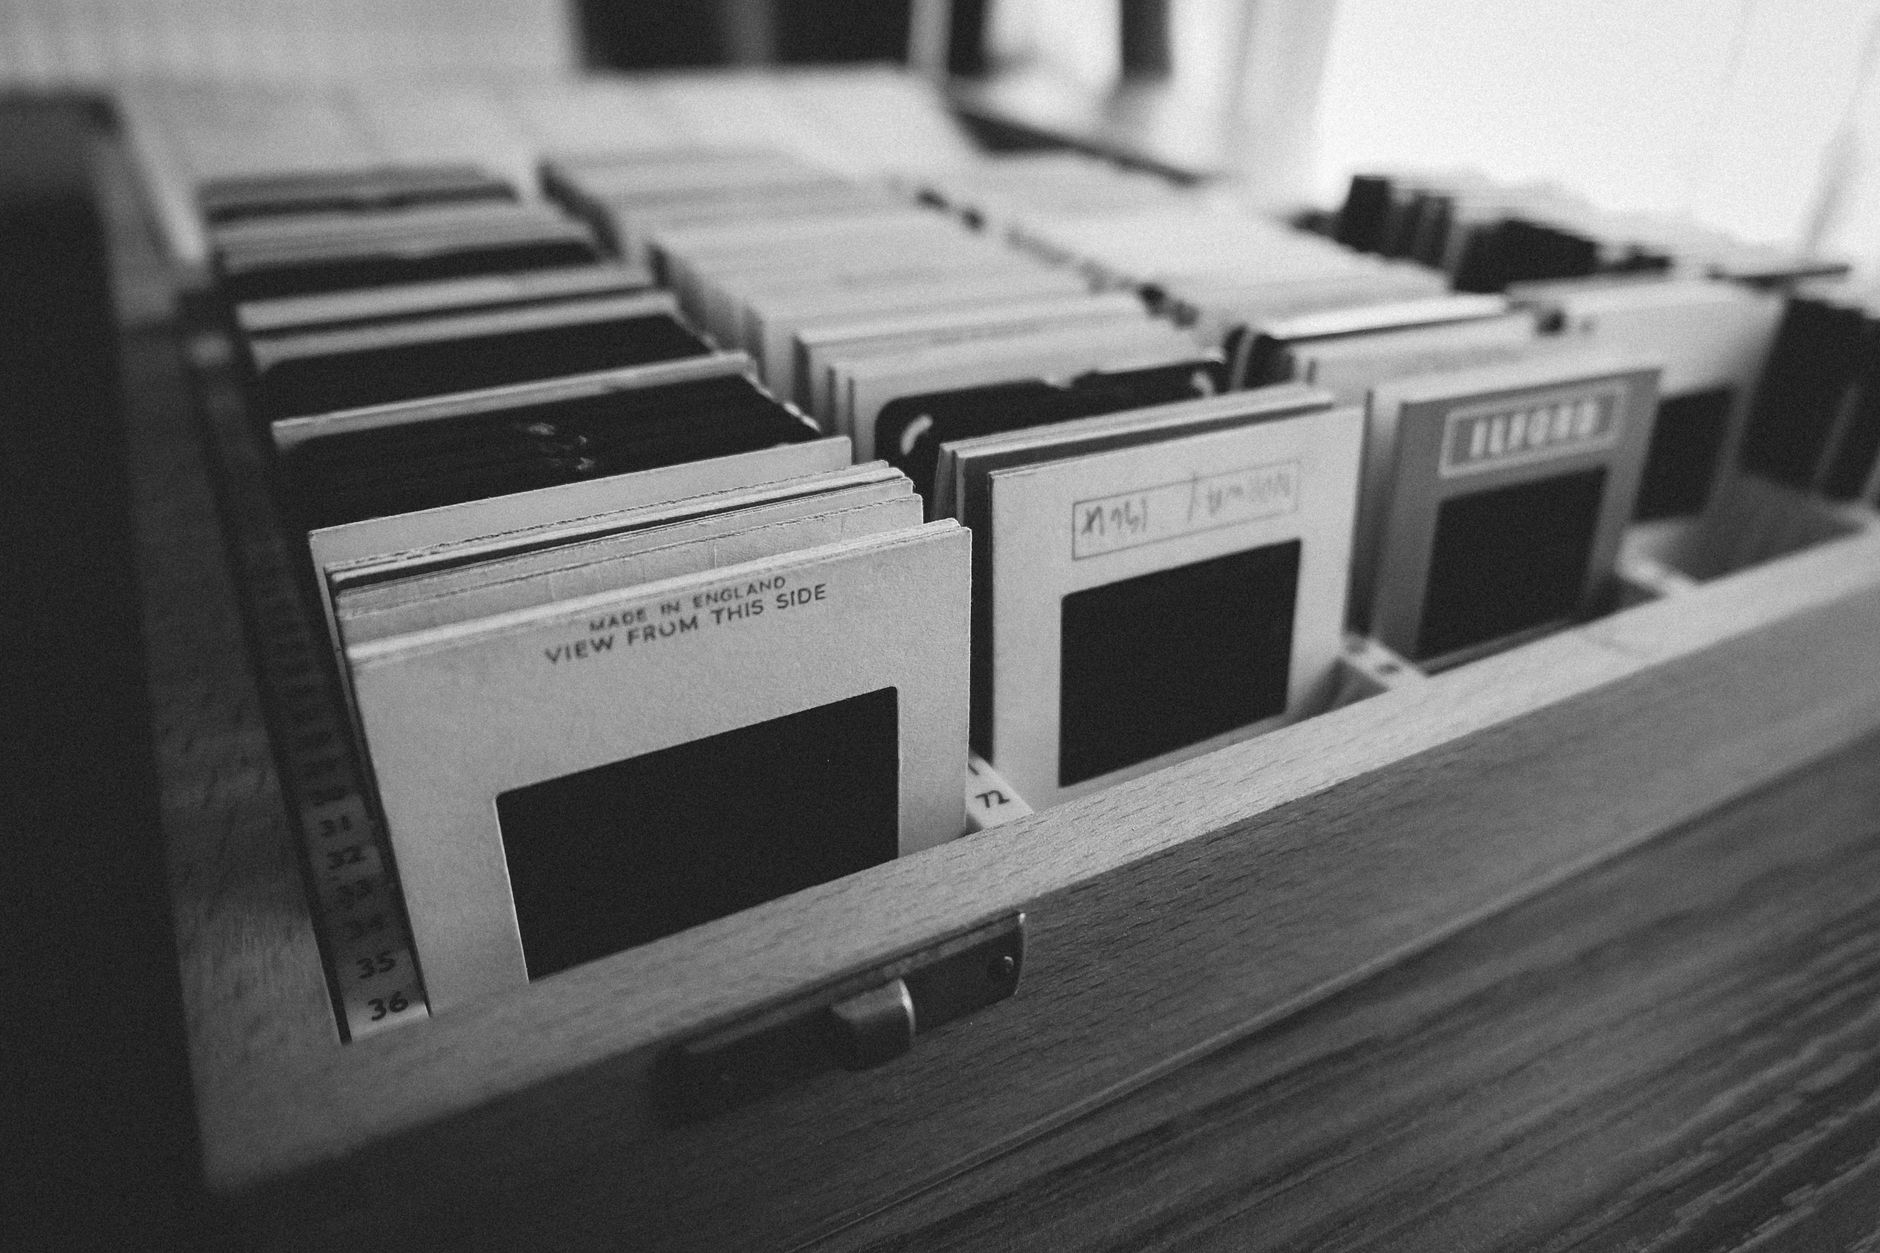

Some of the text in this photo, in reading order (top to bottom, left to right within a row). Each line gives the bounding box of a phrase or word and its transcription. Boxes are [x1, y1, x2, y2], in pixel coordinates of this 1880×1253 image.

[589, 575, 787, 632] MADE IN ENGLAND
[544, 583, 827, 664] VIEW FROM THIS SIDE
[974, 789, 1010, 809] 72
[356, 949, 396, 980] 35
[367, 990, 409, 1022] 36
